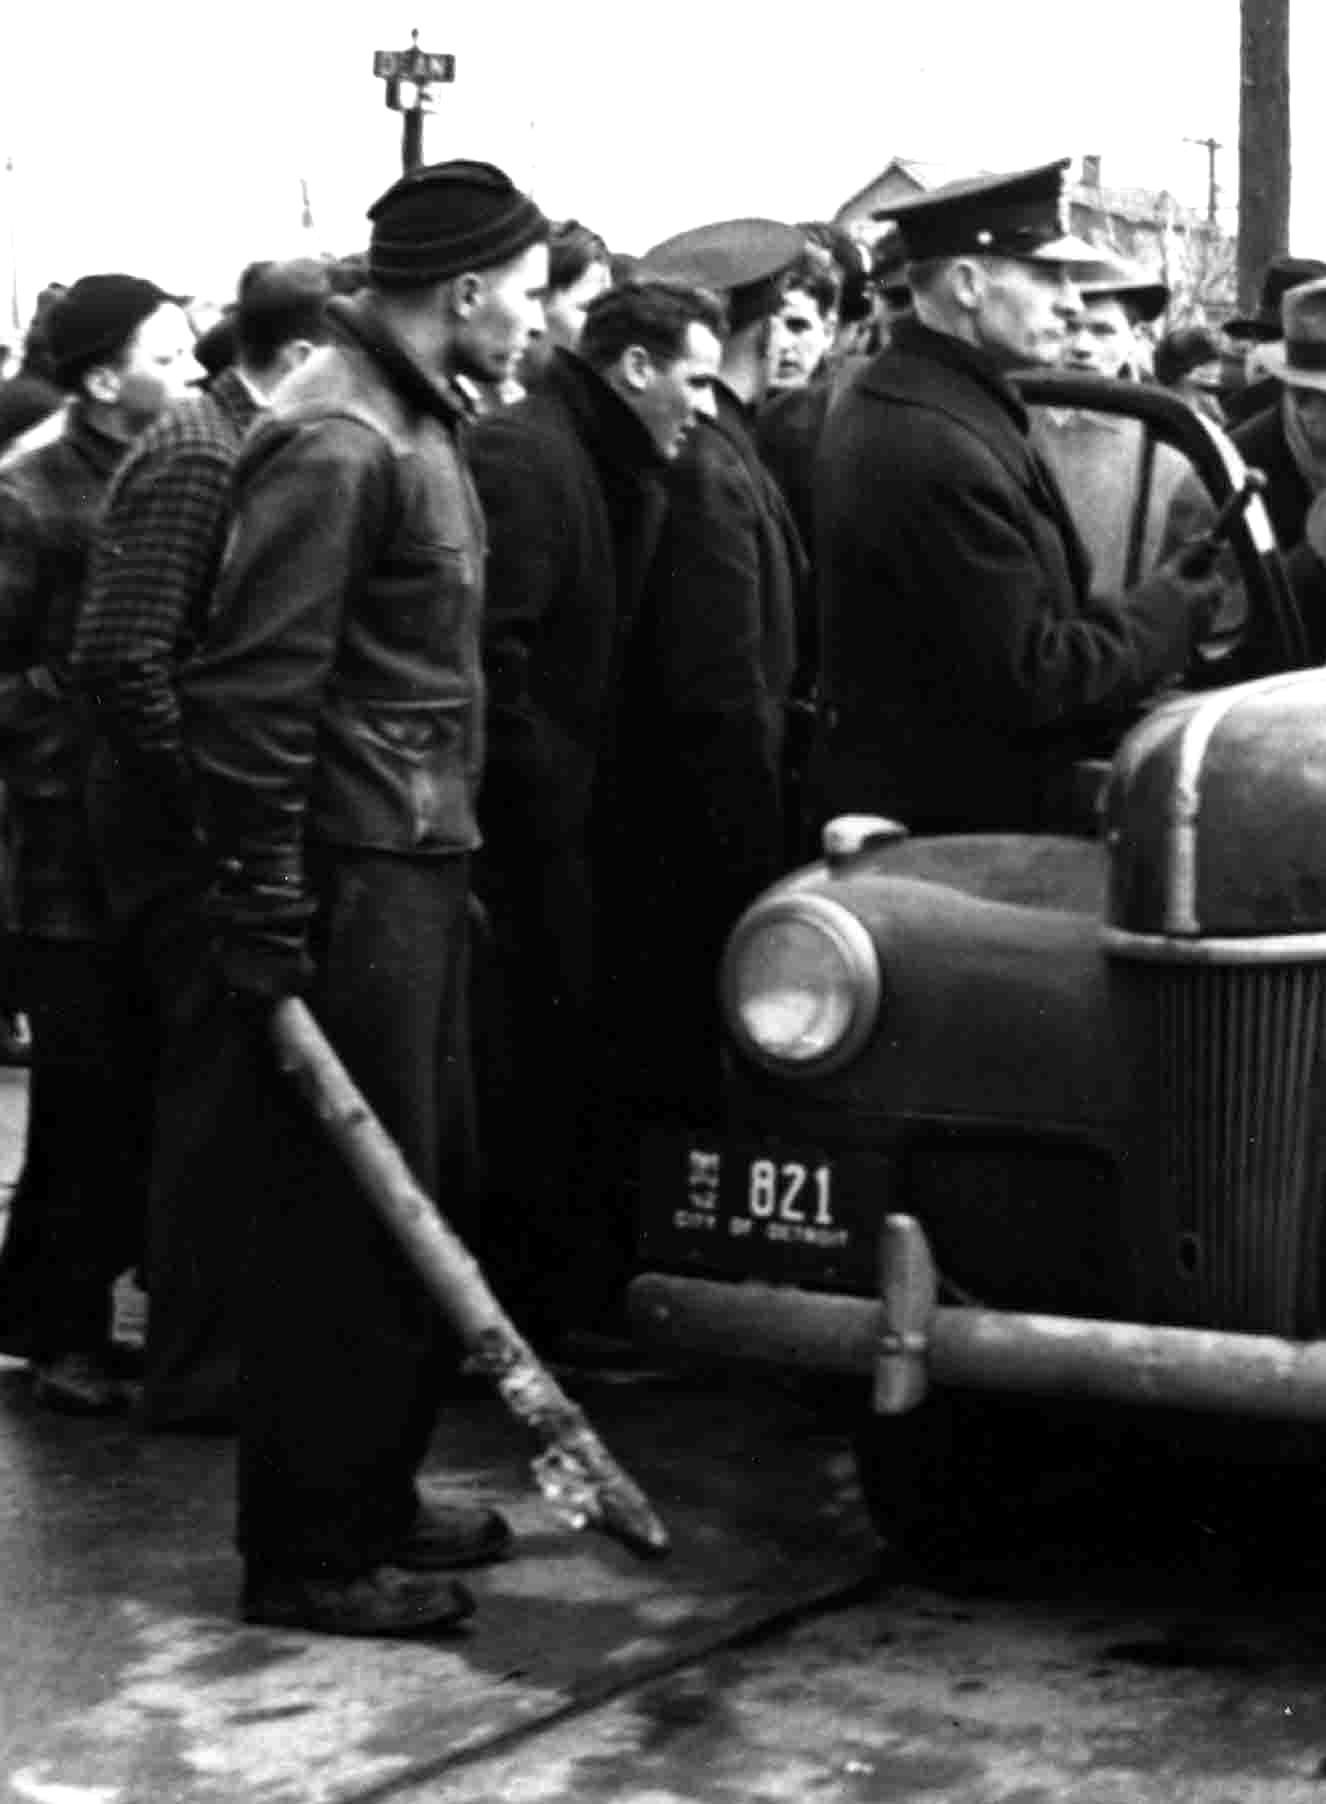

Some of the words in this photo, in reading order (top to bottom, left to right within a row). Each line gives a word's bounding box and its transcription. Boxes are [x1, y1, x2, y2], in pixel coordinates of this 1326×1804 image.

[749, 1159, 833, 1226] 821
[674, 1209, 717, 1229] CITY
[730, 1216, 753, 1236] OF
[766, 1222, 849, 1247] DETROIT
